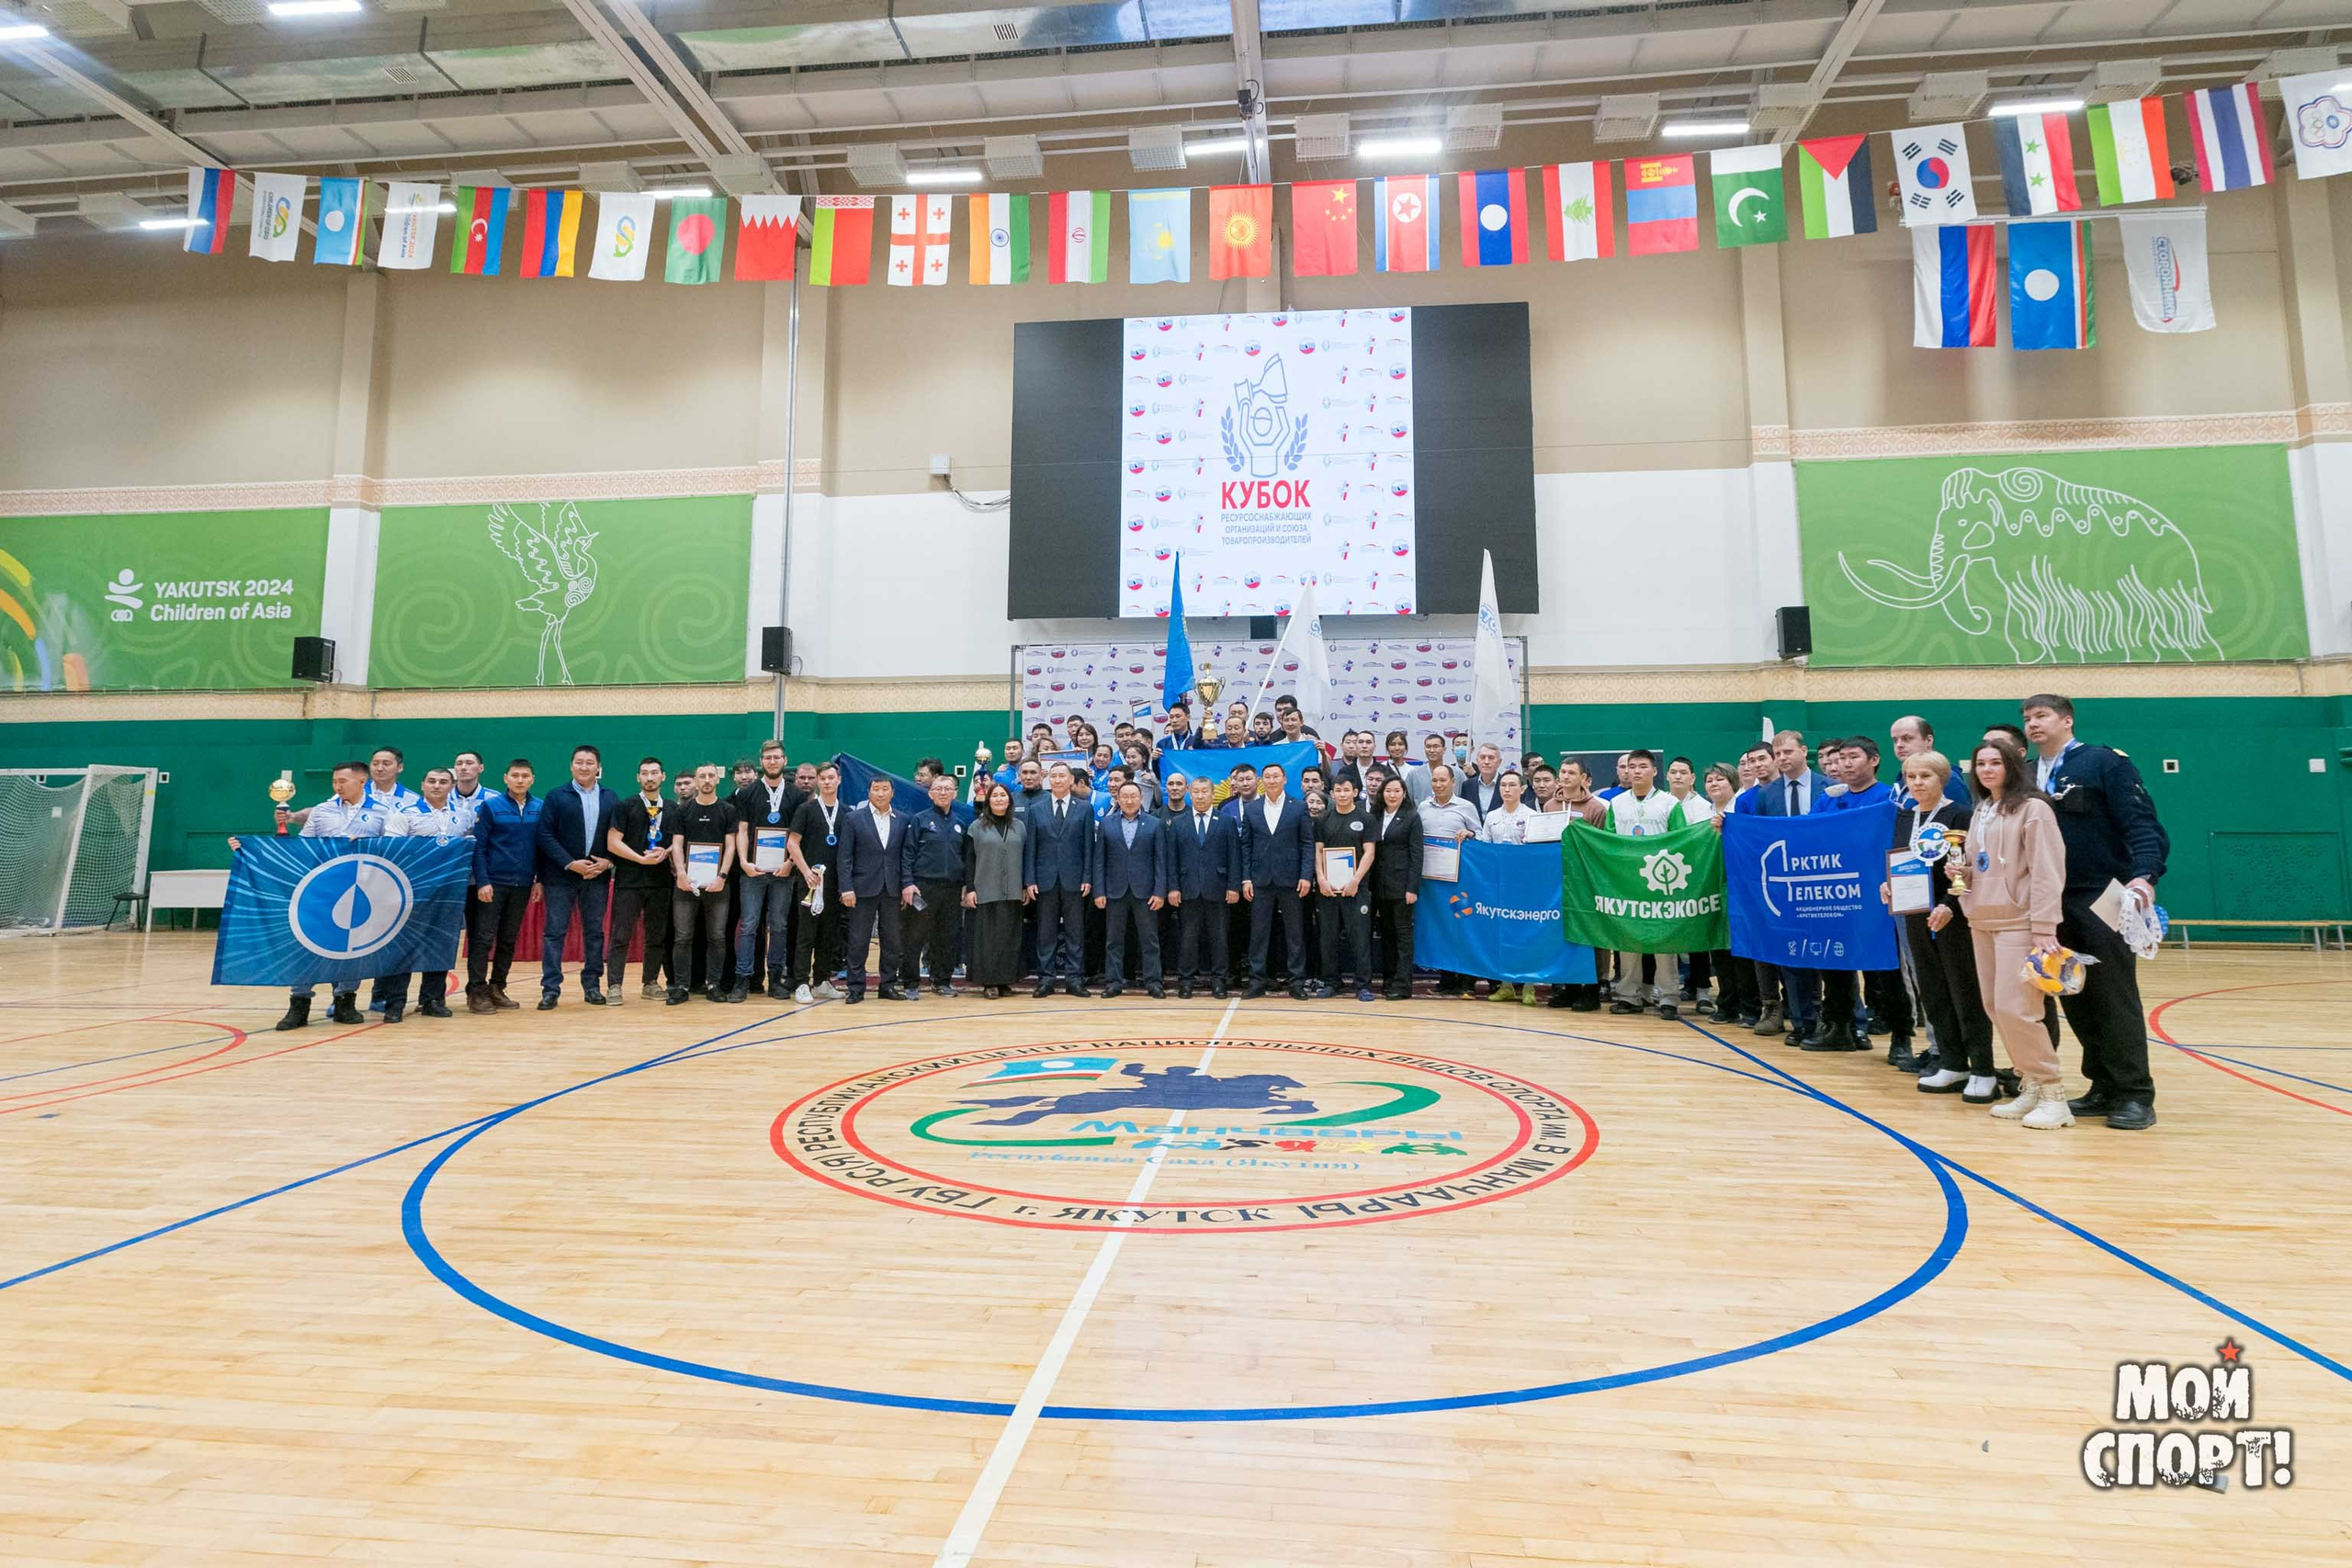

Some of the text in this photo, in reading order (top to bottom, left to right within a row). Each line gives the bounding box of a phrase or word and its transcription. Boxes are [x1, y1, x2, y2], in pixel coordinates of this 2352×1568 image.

[1222, 479, 1311, 510] КУБОК
[1220, 512, 1312, 523] РЕСУРСОСНАБЖАЮЩИХ
[1225, 523, 1308, 534] ОРГАНИЗАЦИЙ И СОЮЗА
[1221, 533, 1312, 546] ТОВАРОПРОИЗВОДИТЕЛЕЙ
[154, 579, 294, 598] YAKUTSK 2024
[150, 602, 292, 622] Children of Asia
[1769, 872, 1861, 902] ТЕЛЕКОМ
[1476, 902, 1561, 923] Якутскэнерго
[972, 1044, 1079, 1061] ЦЕНТР
[1091, 1040, 1385, 1058] НАЦИОНАЛЬНЫХ
[1387, 1055, 1494, 1081] ВИДОВ
[797, 1057, 970, 1153] РЕСПУБЛИКАНСКИЙ
[1487, 1081, 1569, 1121] СПОРТА
[1540, 1122, 1566, 1141] ИМ.
[1532, 1144, 1572, 1155] В
[970, 1151, 1361, 1170] Республика Саха (Якутия)
[895, 1186, 999, 1209] ГБУ
[1296, 1157, 1555, 1219] МАНЧААРЫ
[1013, 1205, 1276, 1223] г. ЯКУТСК
